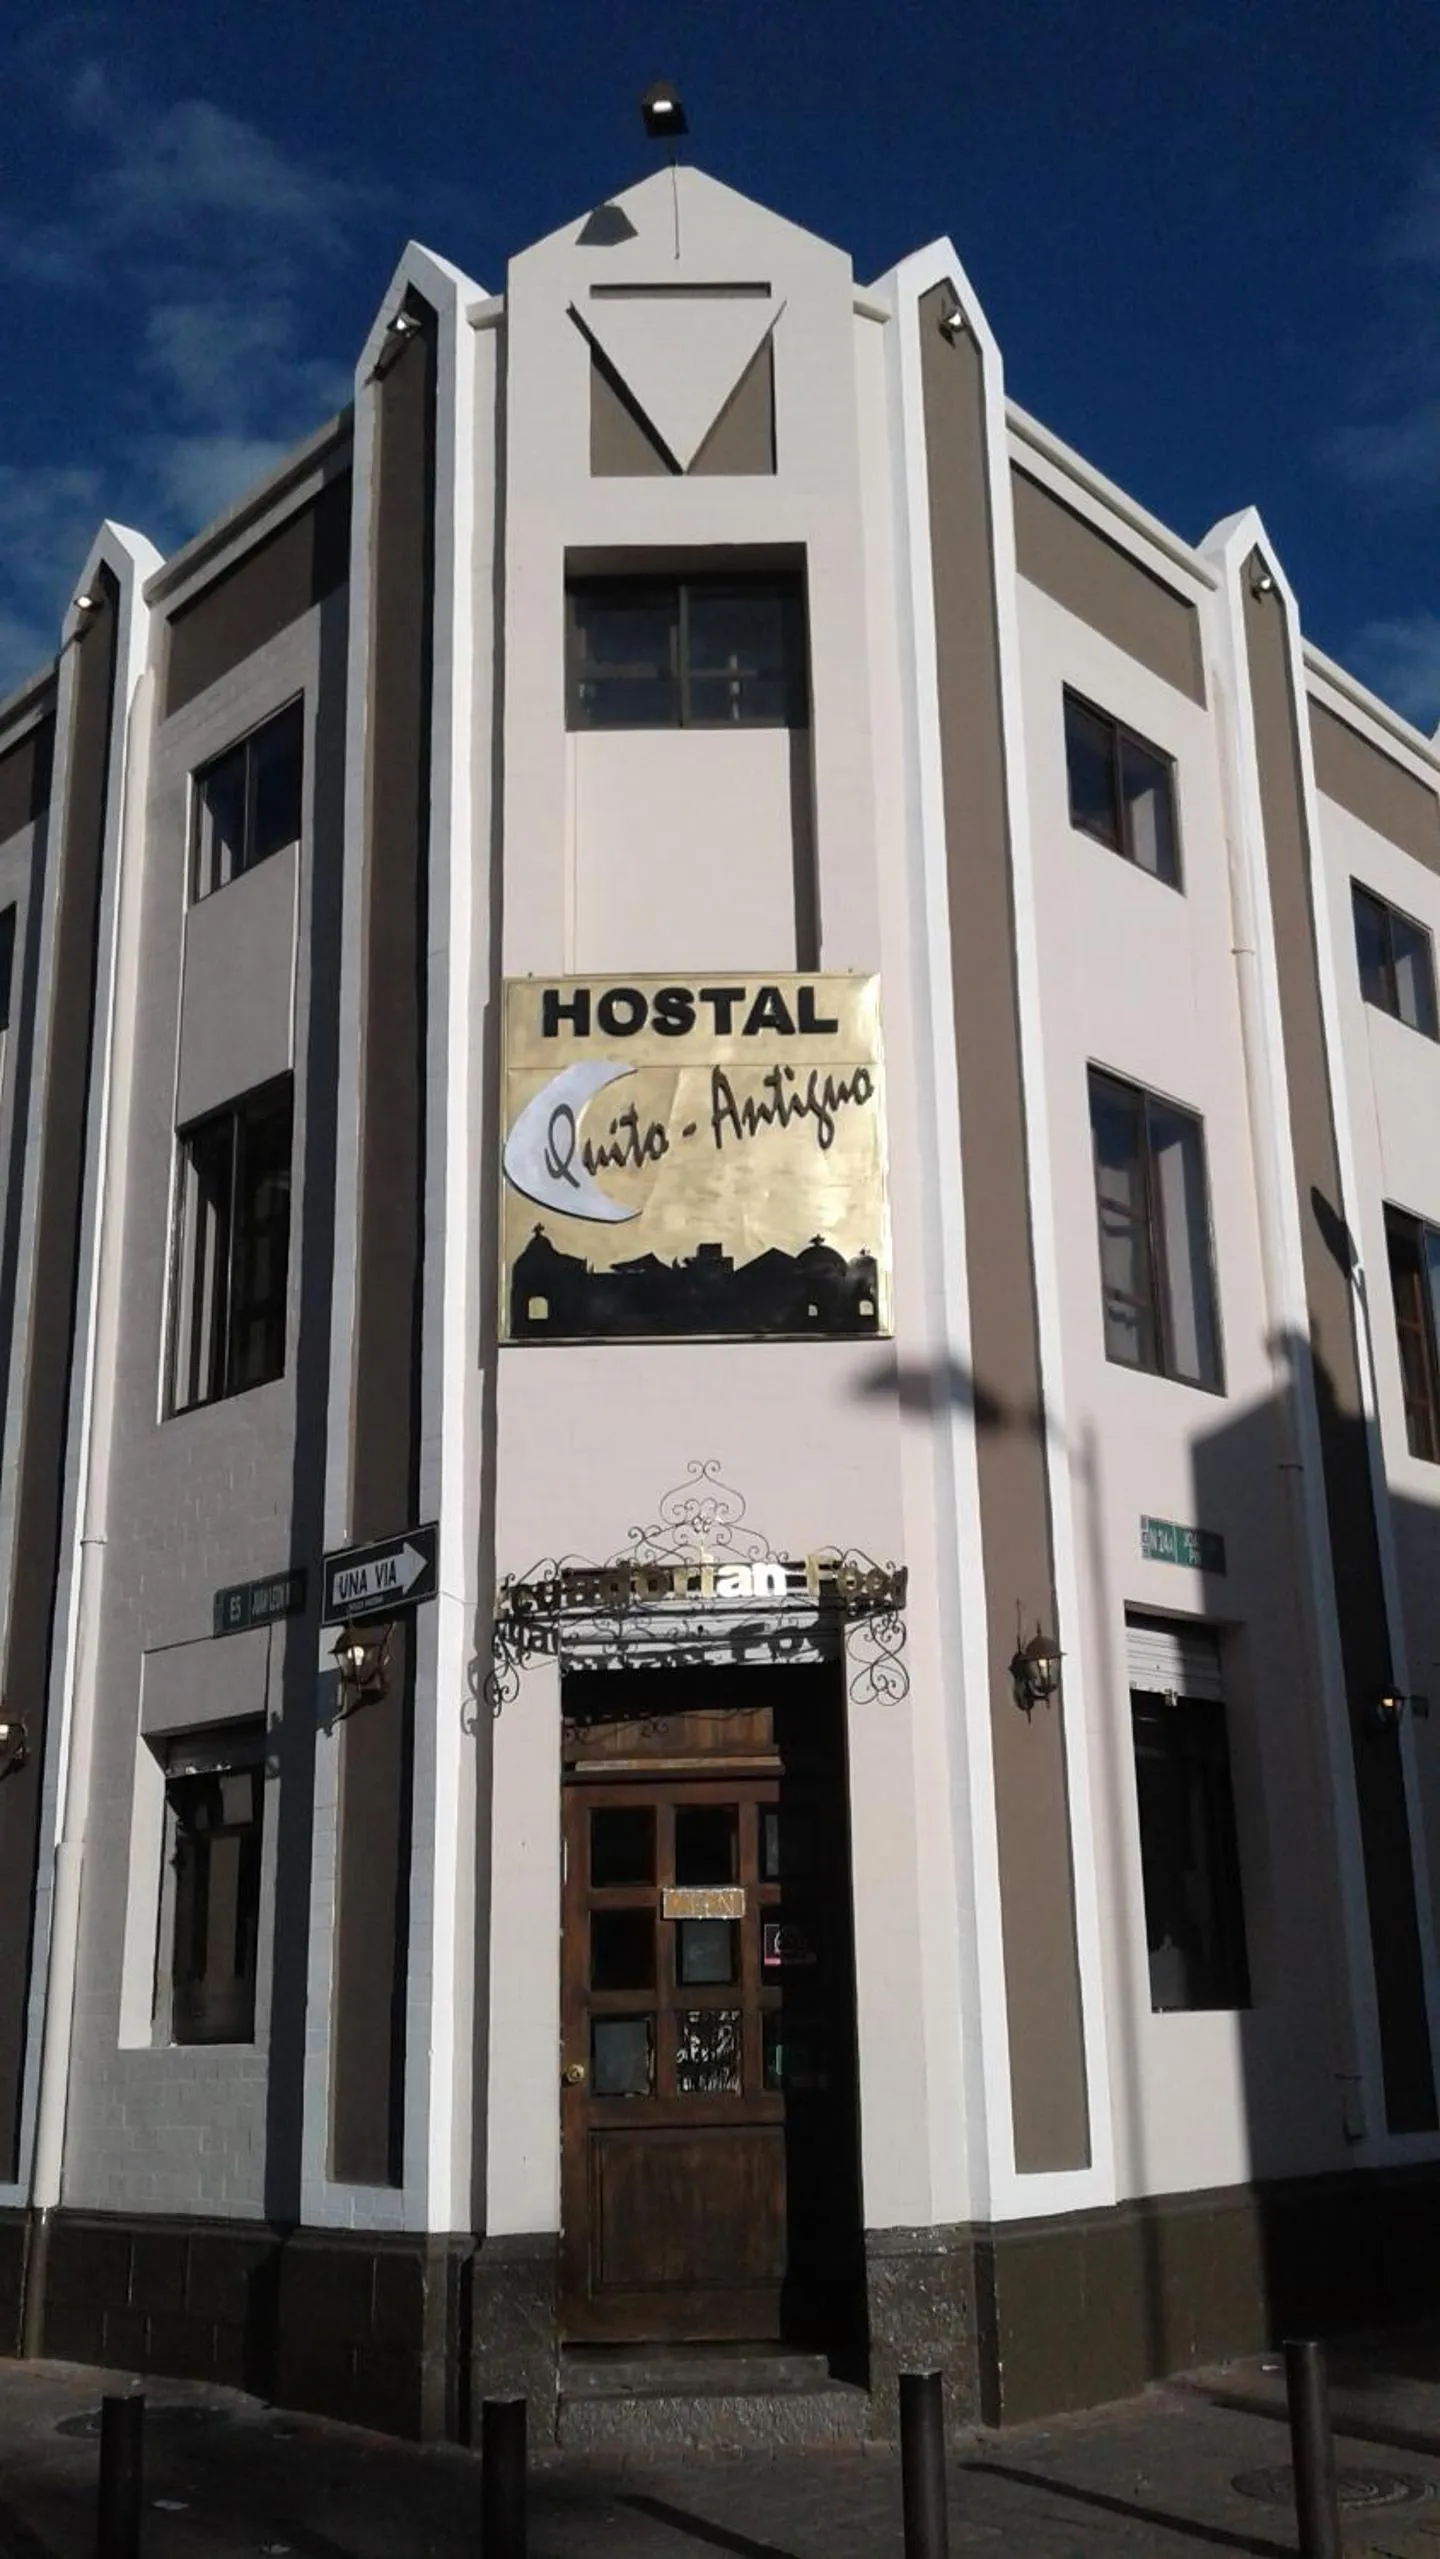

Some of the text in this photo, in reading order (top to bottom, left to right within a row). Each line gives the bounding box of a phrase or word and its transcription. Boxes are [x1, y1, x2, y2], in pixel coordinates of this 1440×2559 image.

[542, 986, 839, 1037] HOSTAL
[544, 1103, 670, 1188] Quito
[711, 1065, 874, 1149] Antiguo
[338, 1569, 368, 1598] UNA
[375, 1560, 397, 1590] VIA
